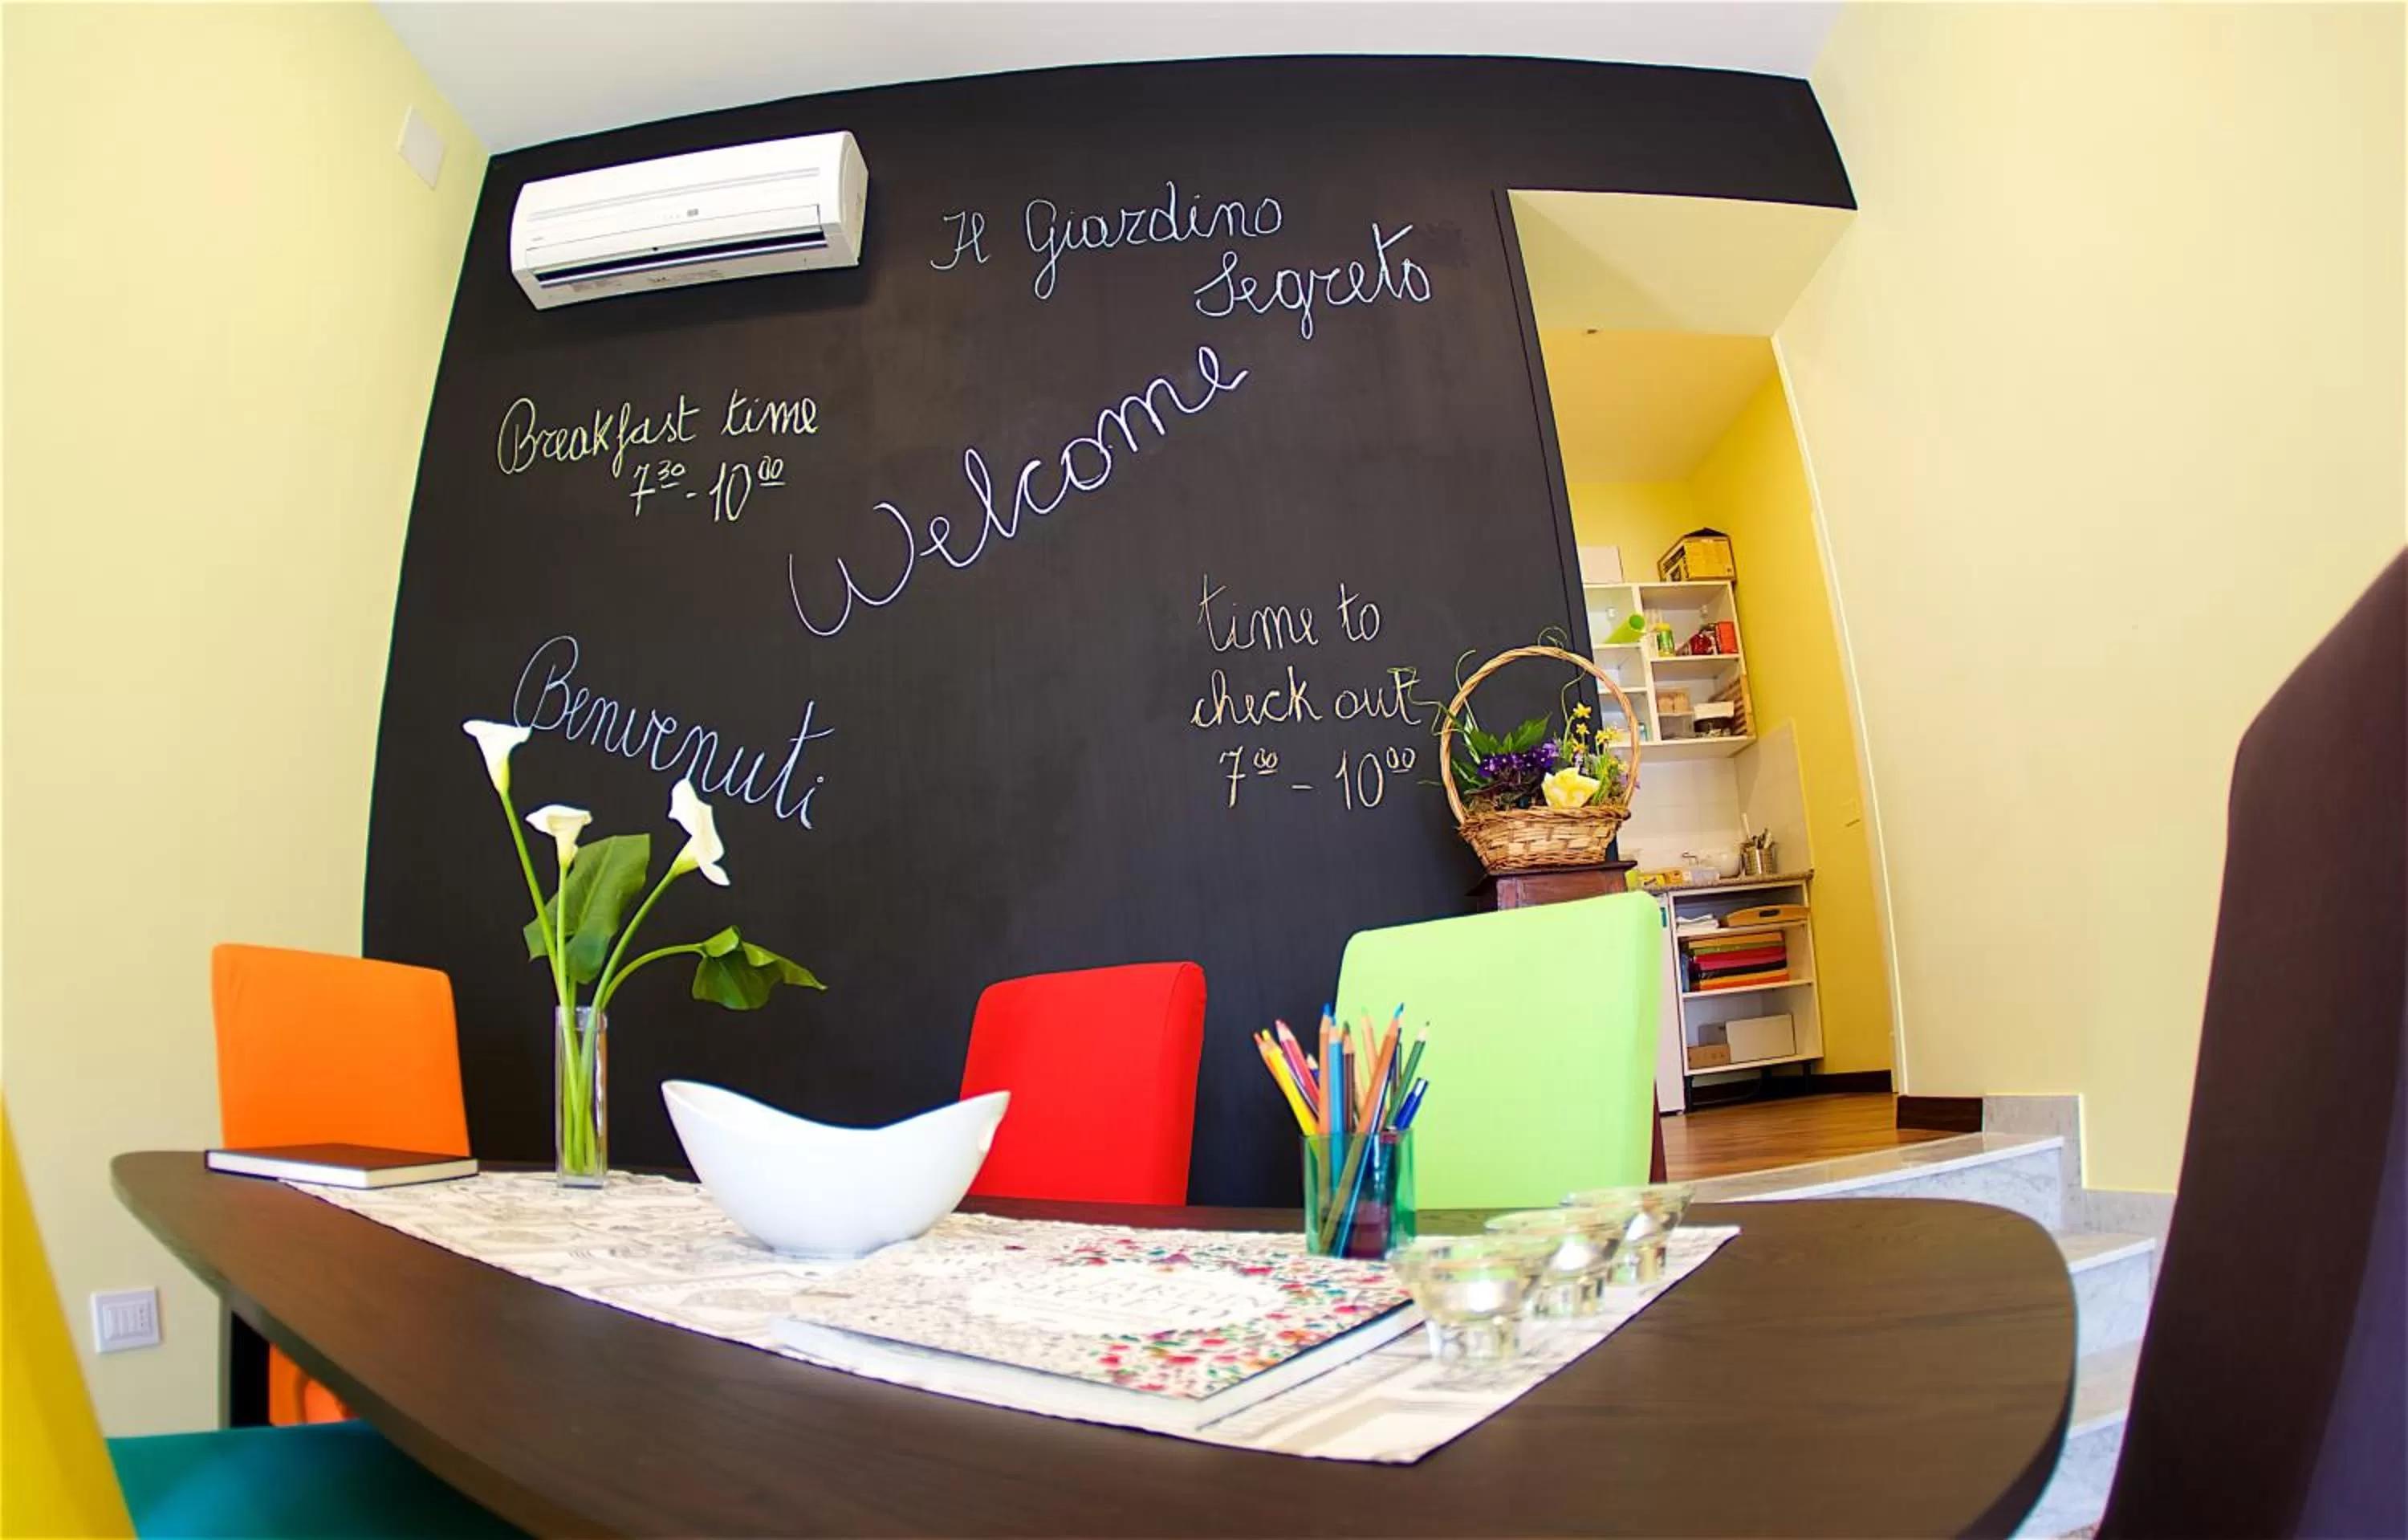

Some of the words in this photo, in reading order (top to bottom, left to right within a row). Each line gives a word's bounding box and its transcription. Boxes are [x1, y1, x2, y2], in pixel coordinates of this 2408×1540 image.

[929, 210, 991, 269] Il
[1024, 181, 1283, 299] Giardino
[1194, 222, 1432, 339] Segreto
[497, 394, 701, 479] Breakfast
[721, 388, 820, 437] time
[788, 345, 1250, 637] Welcome
[1197, 573, 1320, 652] time
[1336, 582, 1381, 642] to
[512, 634, 836, 830] Benvenuti
[1190, 665, 1324, 729] check
[1334, 668, 1422, 726] out
